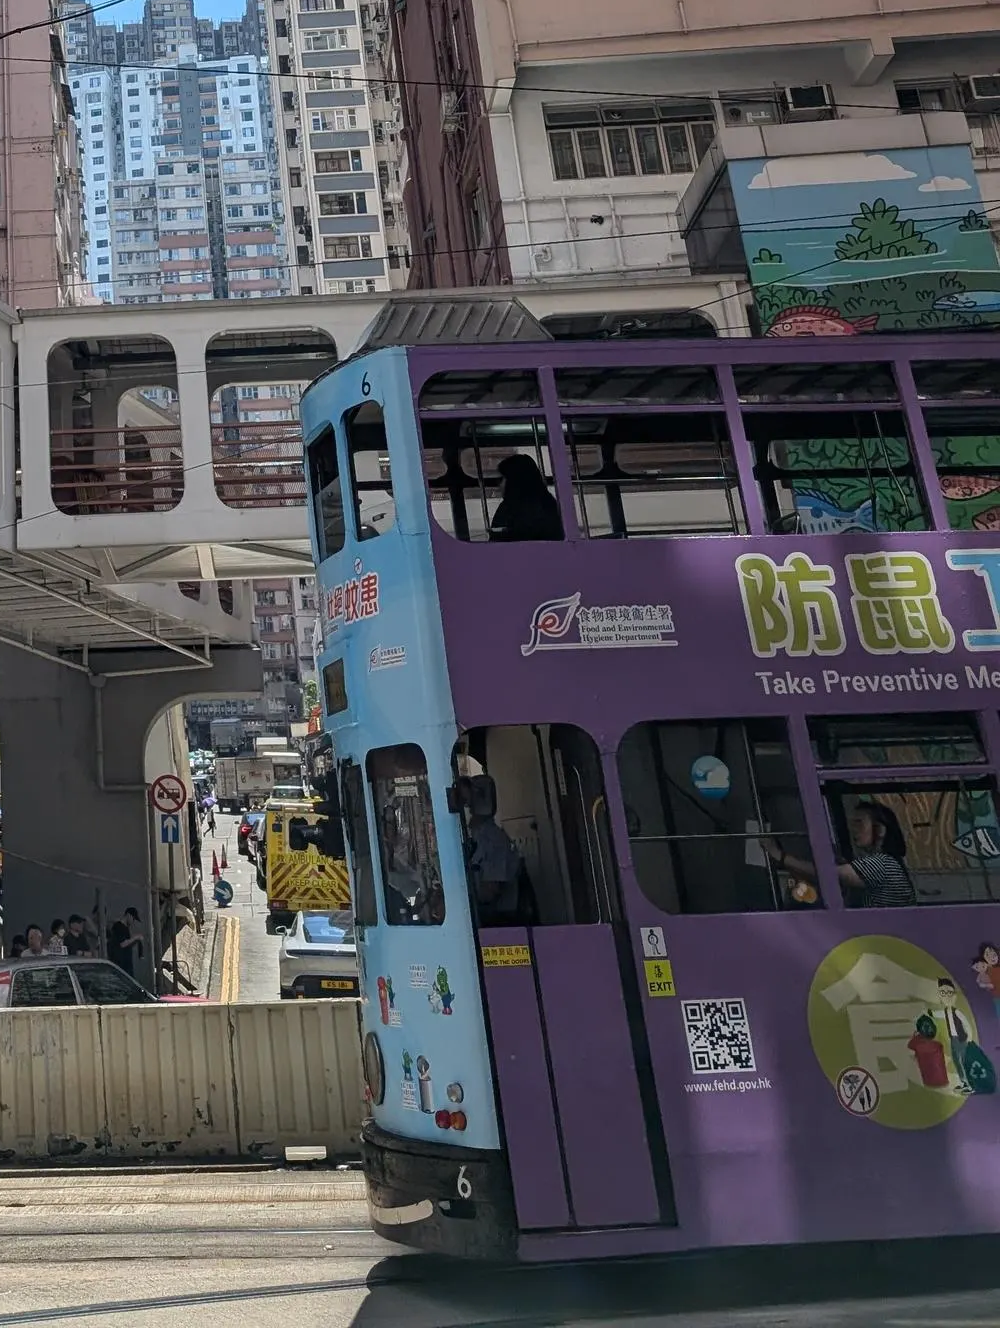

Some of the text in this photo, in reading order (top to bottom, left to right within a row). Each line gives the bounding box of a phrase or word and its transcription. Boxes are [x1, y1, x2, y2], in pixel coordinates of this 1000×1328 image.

[360, 370, 371, 397] 6
[581, 622, 673, 633] Food and Environmental
[582, 633, 660, 644] Hygiene Department
[754, 671, 816, 695] Take
[822, 667, 960, 694] Preventive
[288, 853, 338, 865] AMBULANC
[291, 879, 337, 888] KEEP CLEAR
[649, 981, 673, 992] EXIT
[684, 1076, 772, 1094] www.fehd.gov.hk
[457, 1165, 472, 1199] 6
